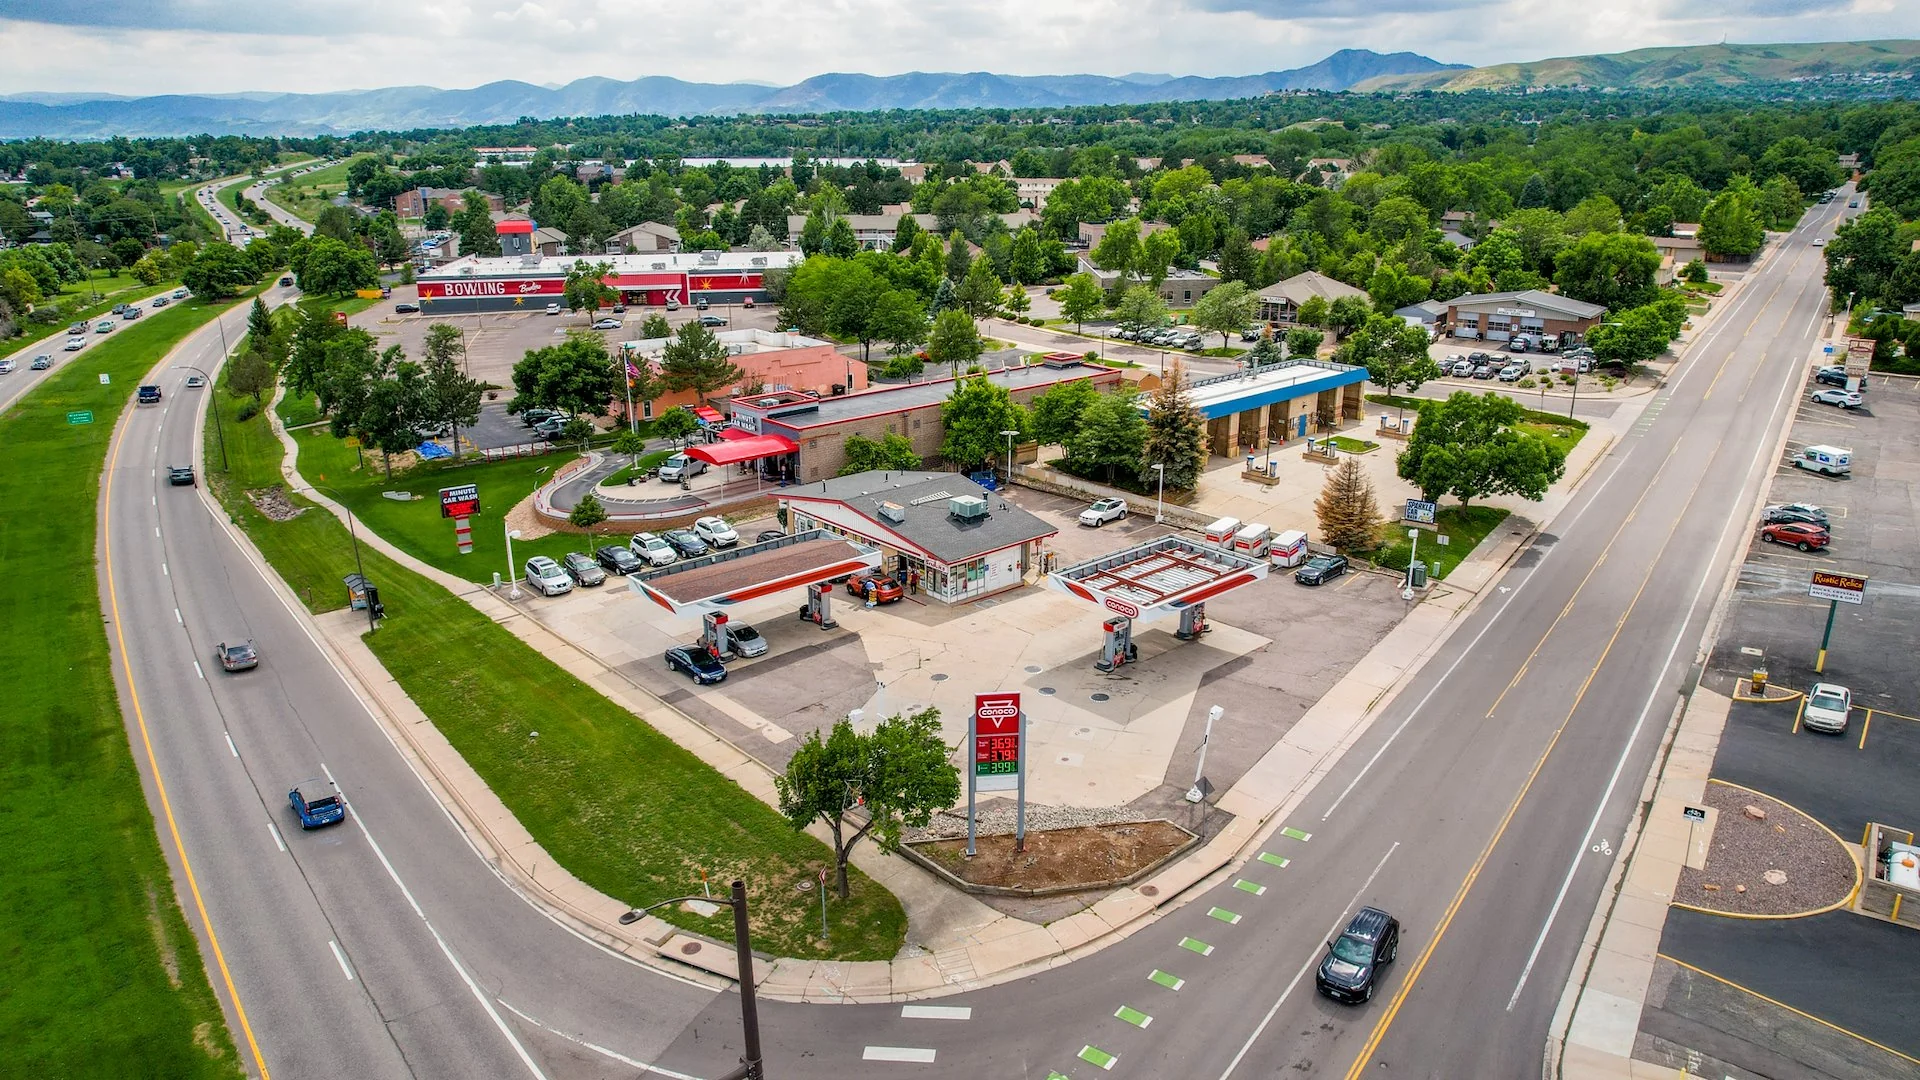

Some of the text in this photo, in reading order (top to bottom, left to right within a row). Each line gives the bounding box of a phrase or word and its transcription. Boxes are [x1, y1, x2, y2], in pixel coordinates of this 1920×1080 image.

[444, 282, 506, 296] BOWLING
[449, 487, 476, 497] MINUTE
[442, 493, 478, 504] CAR WASH
[1407, 507, 1418, 515] CAR
[1408, 501, 1433, 512] SPARKLE
[1814, 573, 1863, 588] Rustic Relics
